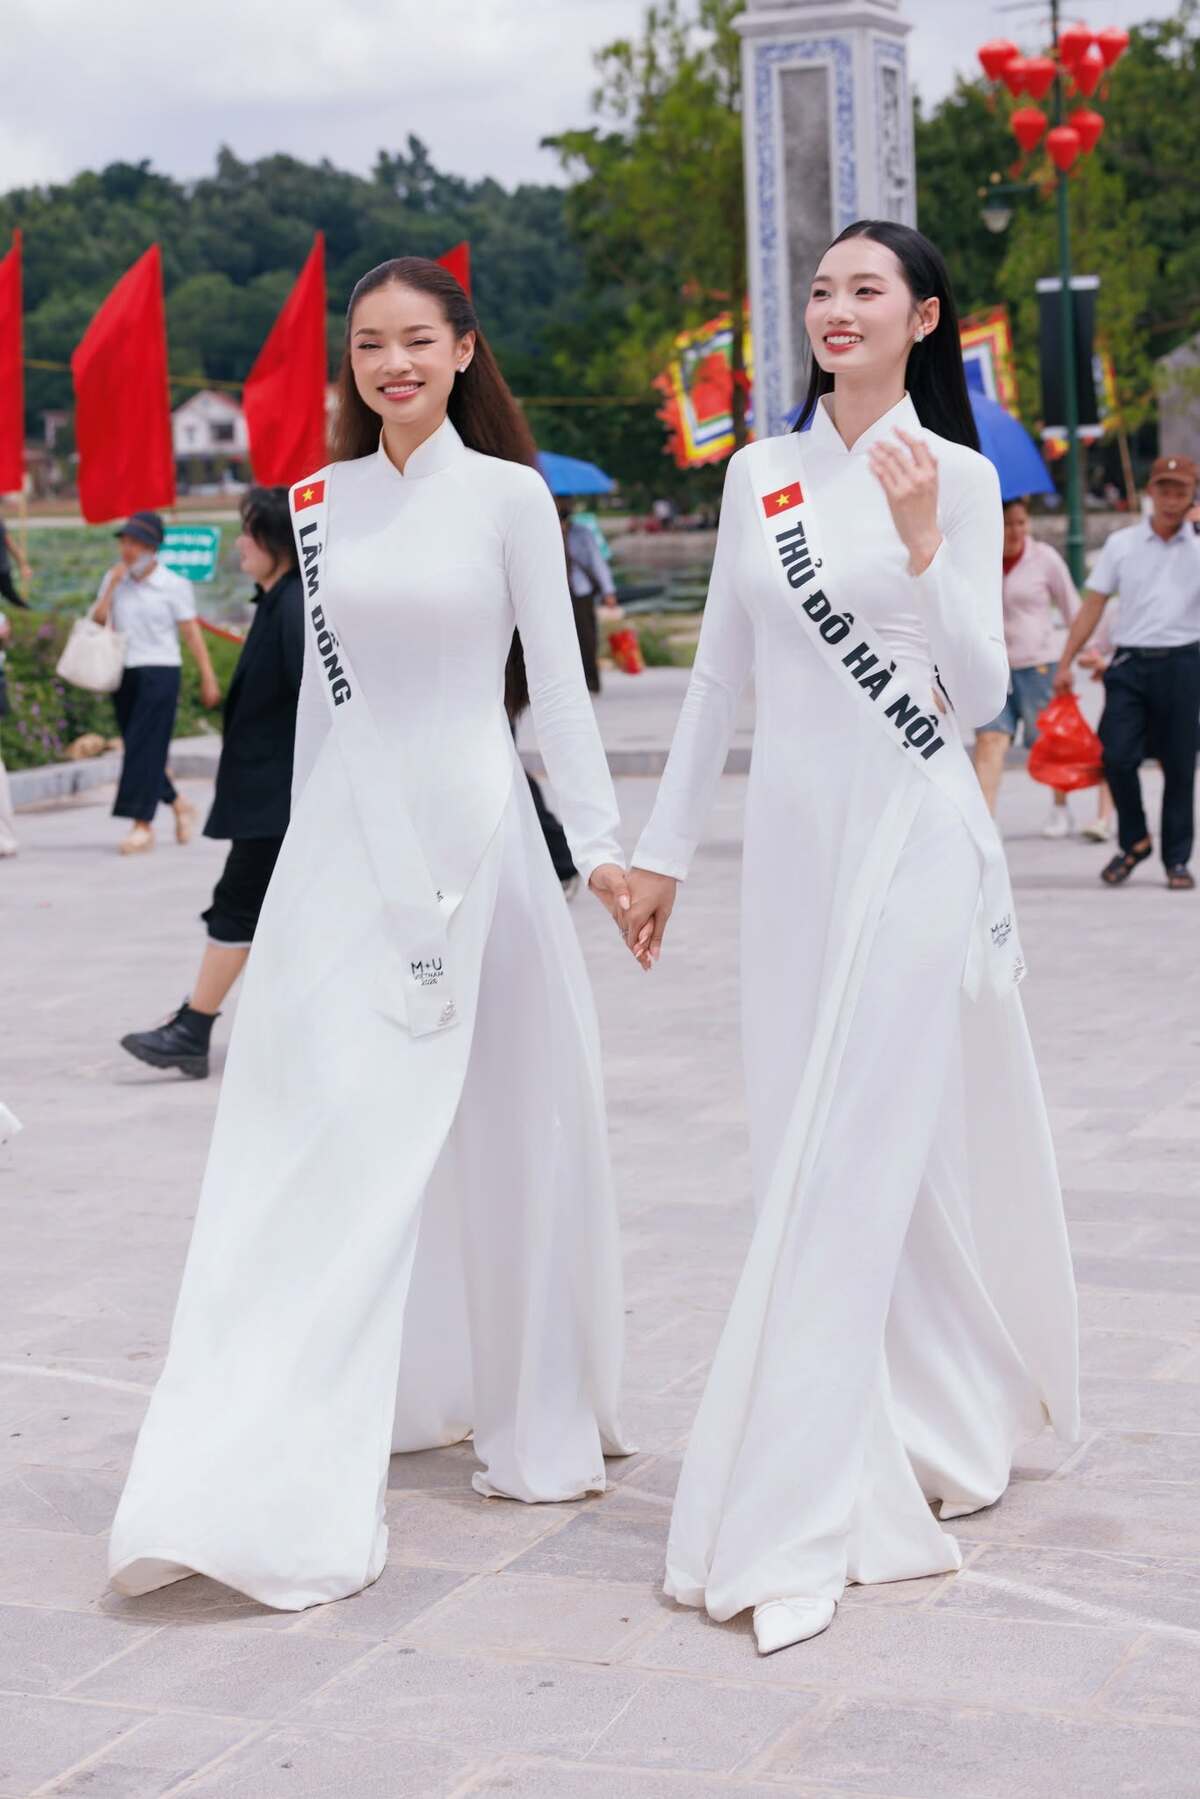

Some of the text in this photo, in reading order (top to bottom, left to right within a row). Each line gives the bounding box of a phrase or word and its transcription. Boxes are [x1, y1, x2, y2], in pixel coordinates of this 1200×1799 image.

[299, 522, 323, 597] LÂM
[775, 520, 945, 760] THỦ ĐÔ HÀ NỘI
